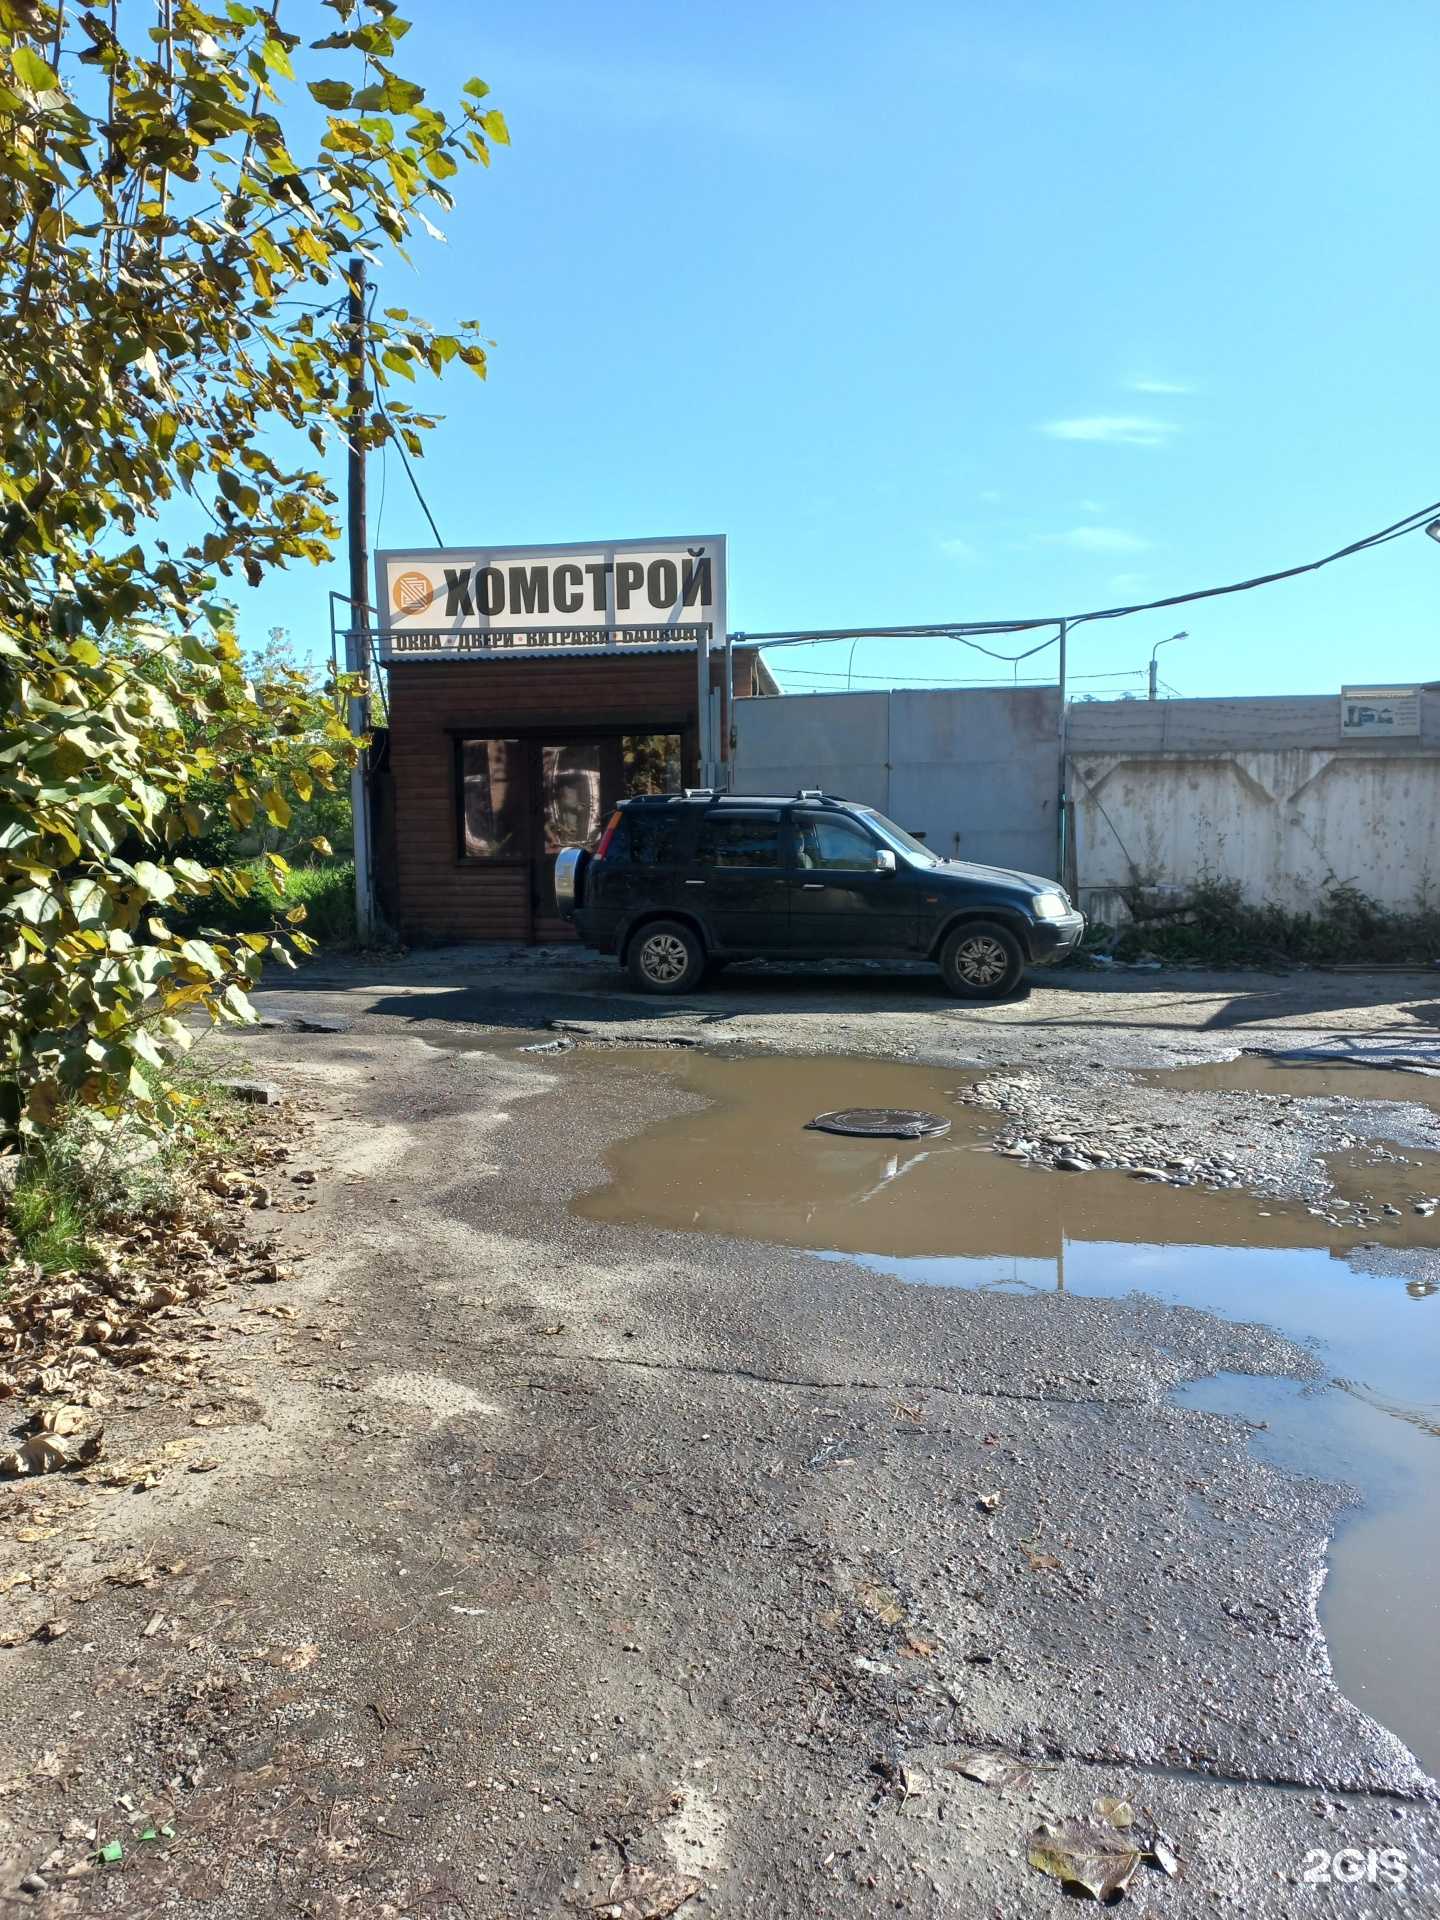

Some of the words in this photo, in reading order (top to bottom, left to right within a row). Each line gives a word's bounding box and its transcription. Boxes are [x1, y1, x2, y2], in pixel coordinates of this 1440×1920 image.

[444, 547, 712, 616] ХОМСТРОЙ
[396, 633, 442, 651] ОКНА
[456, 631, 515, 652] ДВЕРИ
[526, 627, 610, 647] ВИТРАЖИ
[622, 622, 713, 643] БАЛКОН
